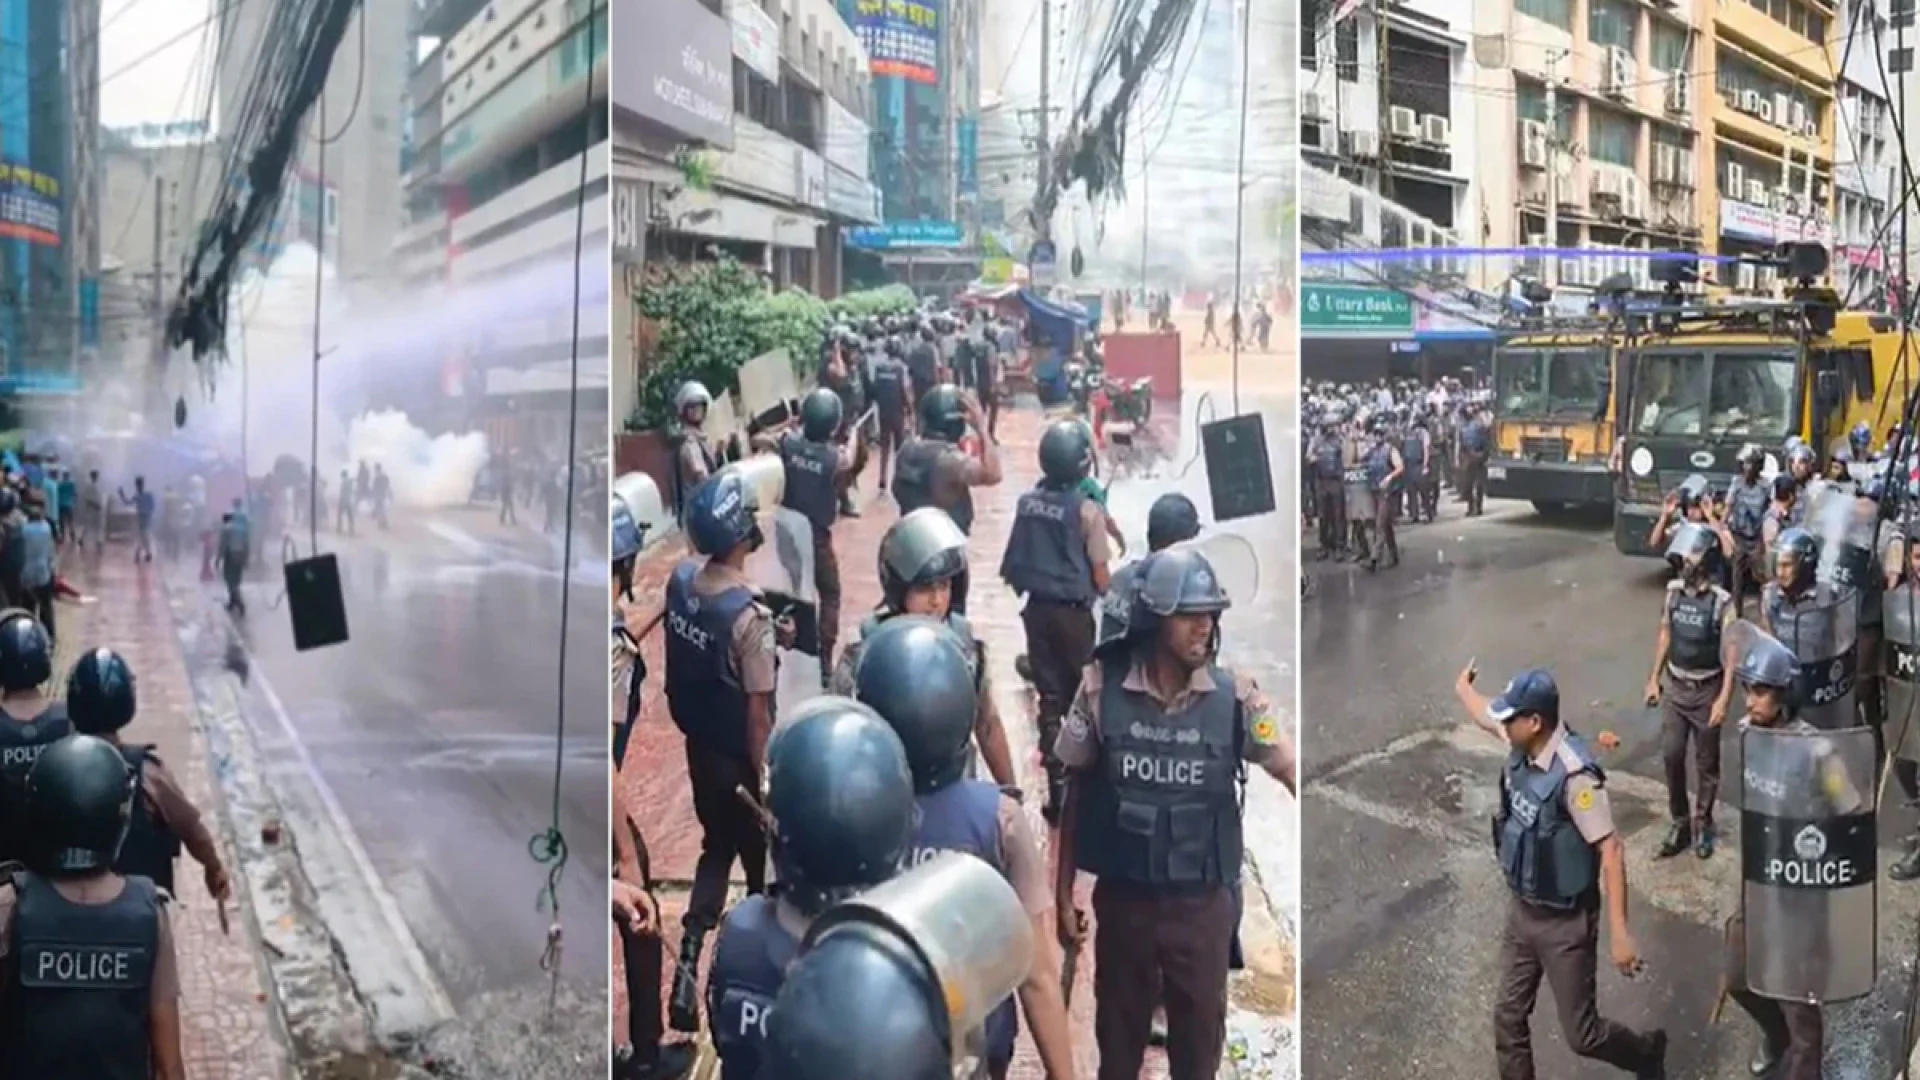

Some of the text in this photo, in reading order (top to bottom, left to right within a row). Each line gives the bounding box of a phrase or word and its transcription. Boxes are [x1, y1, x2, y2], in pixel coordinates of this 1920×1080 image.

[1025, 499, 1066, 520] POLICE
[670, 611, 708, 650] POLICE
[1122, 754, 1205, 785] POLICE
[1769, 858, 1852, 885] POLICE
[38, 951, 129, 981] POLICE
